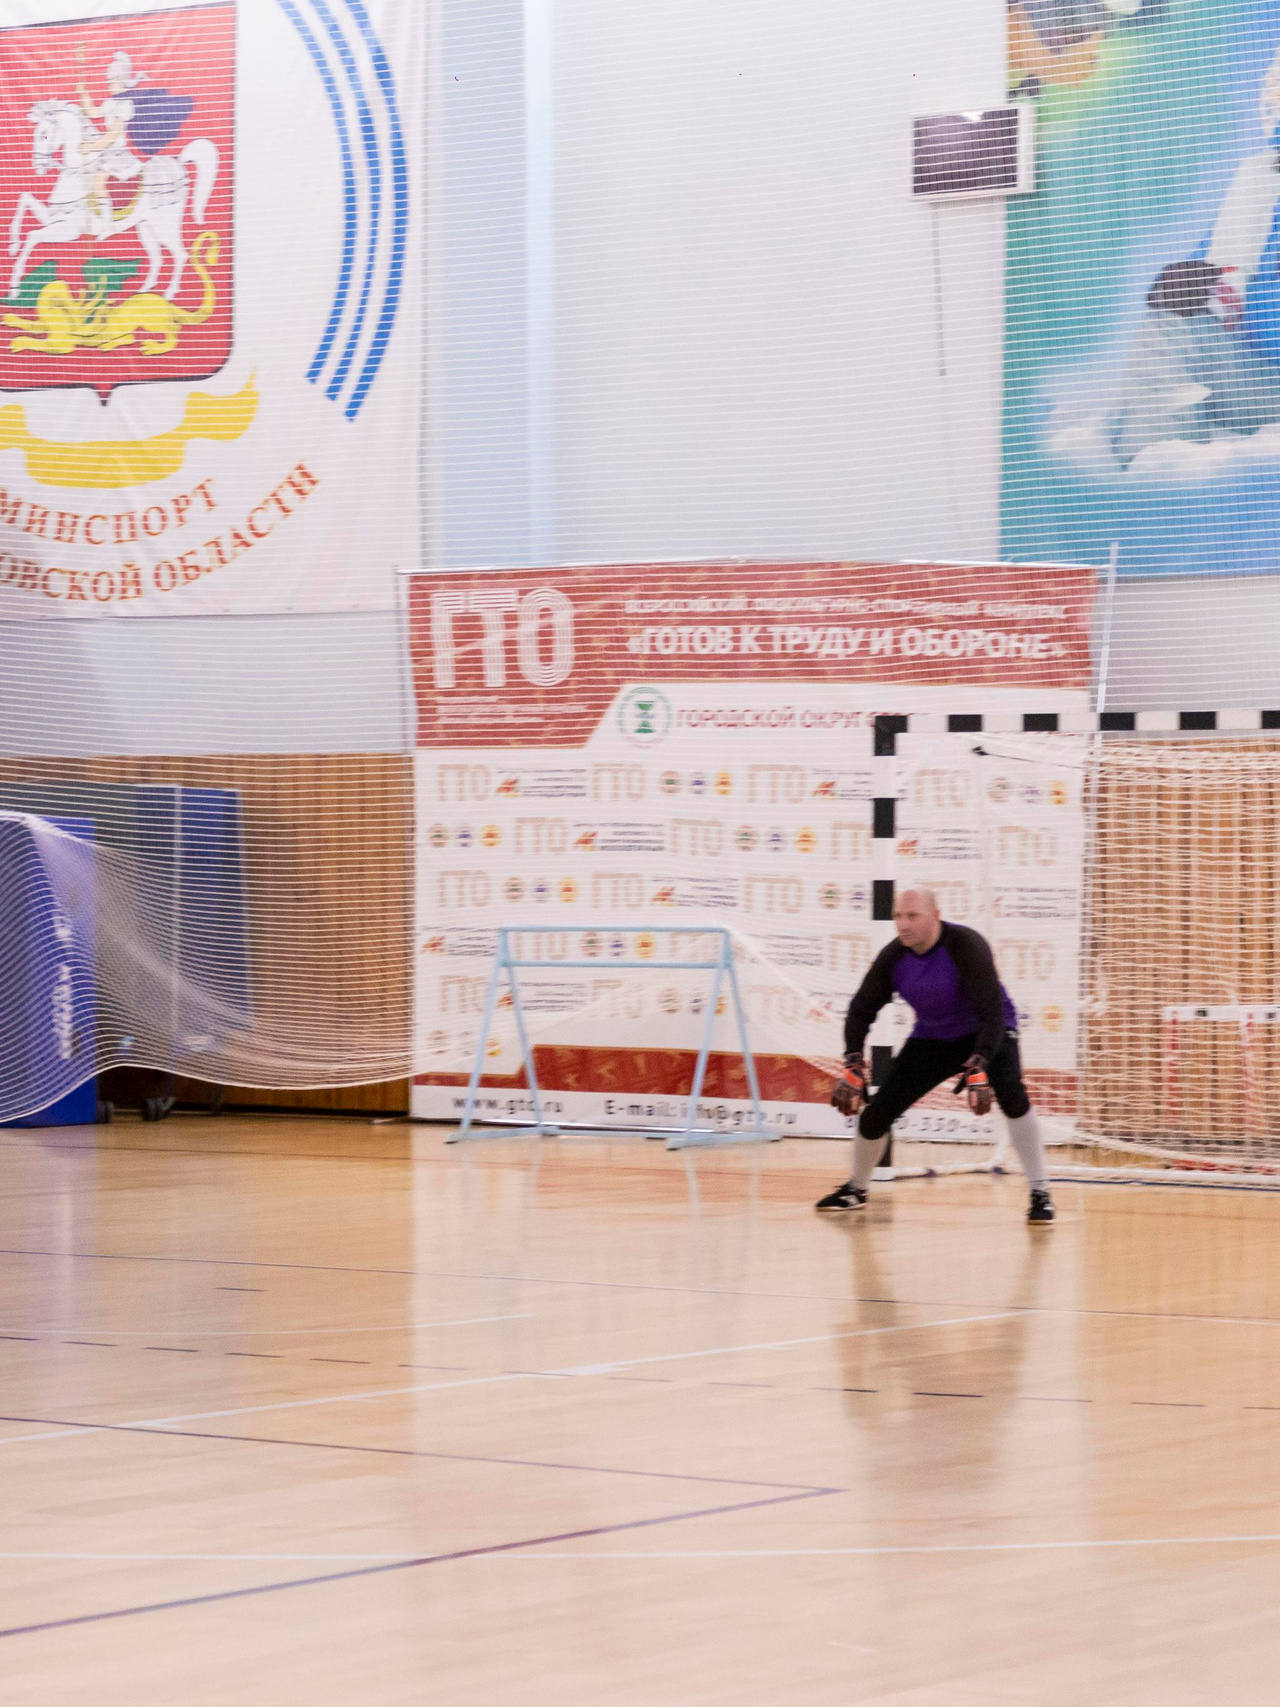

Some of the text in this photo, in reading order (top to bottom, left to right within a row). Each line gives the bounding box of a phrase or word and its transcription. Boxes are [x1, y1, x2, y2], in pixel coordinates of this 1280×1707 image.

[153, 461, 321, 592] ОБЛАСТИ
[430, 587, 575, 688] ГТО
[740, 625, 762, 654] К
[767, 625, 865, 660] ТРУДУ
[869, 627, 894, 656] И
[676, 705, 797, 729] ГОРОДСКОЙ
